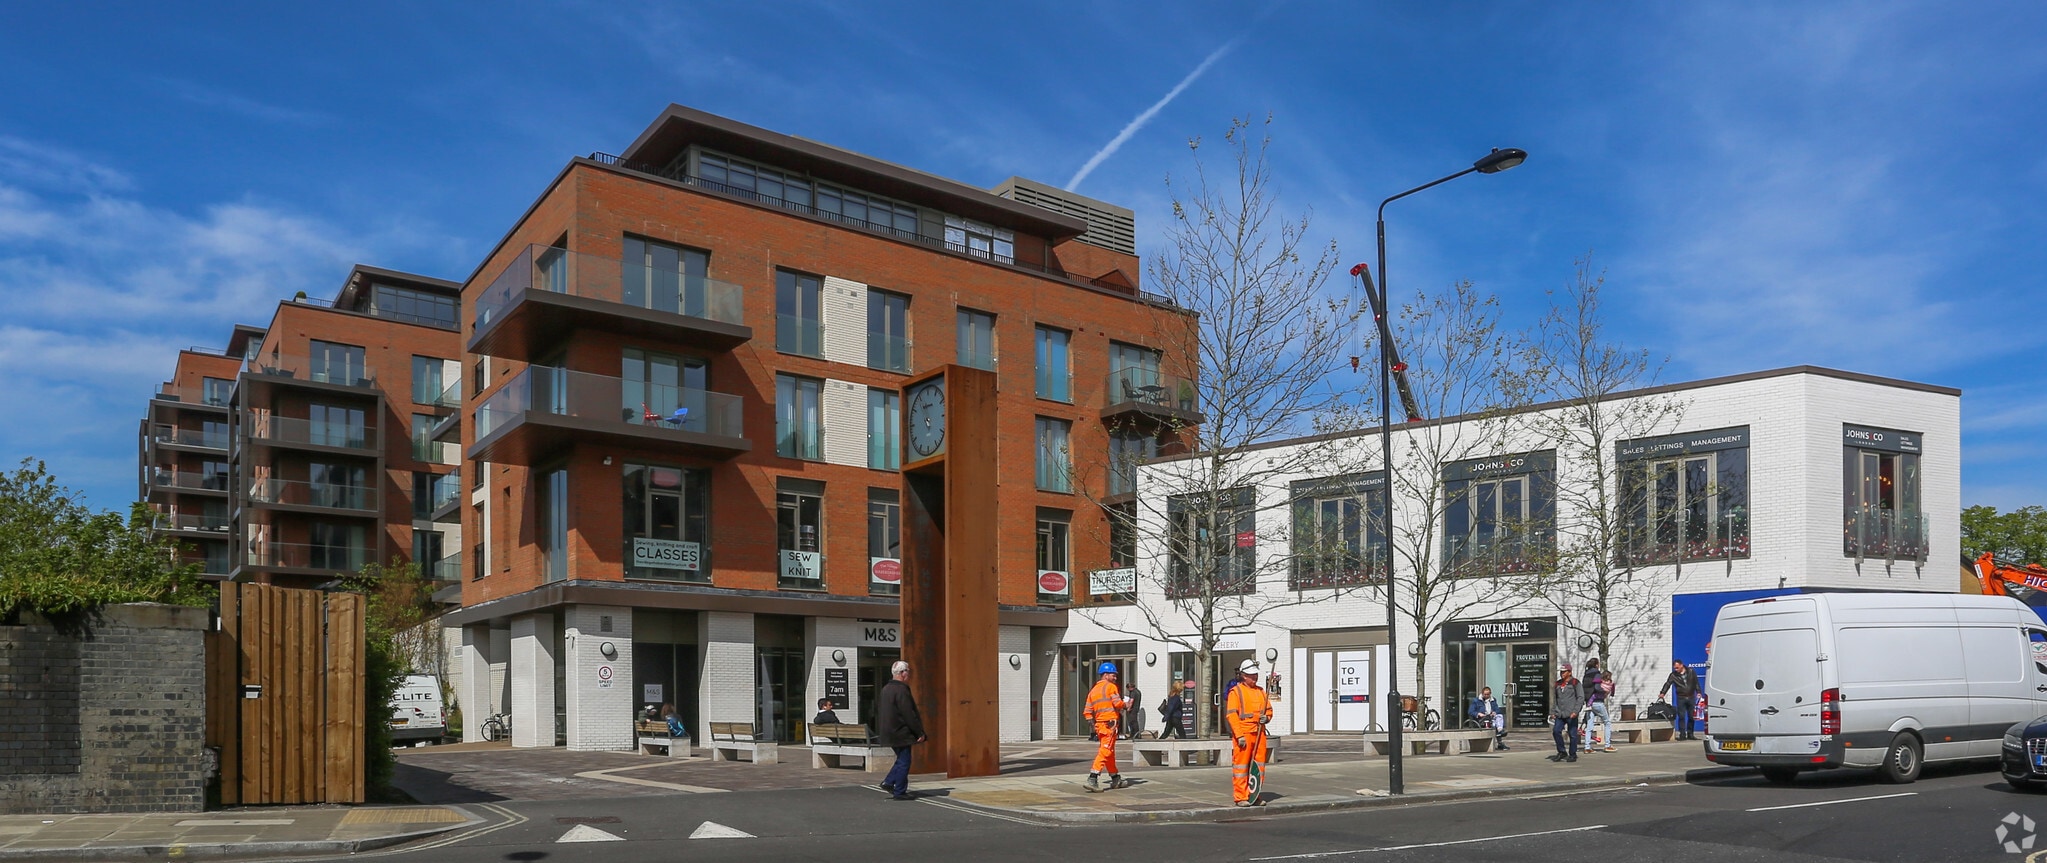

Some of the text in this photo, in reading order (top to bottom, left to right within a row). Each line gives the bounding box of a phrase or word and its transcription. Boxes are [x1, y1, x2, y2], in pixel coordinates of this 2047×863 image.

[1691, 435, 1742, 447] MANAGEMENT
[636, 546, 698, 562] CLASSES
[788, 552, 812, 562] SEW
[788, 567, 812, 576] KNIT
[1092, 574, 1134, 585] THURSDAYS
[1468, 622, 1529, 634] PROVENANCE
[865, 627, 896, 642] M&S
[1342, 677, 1360, 685] LET
